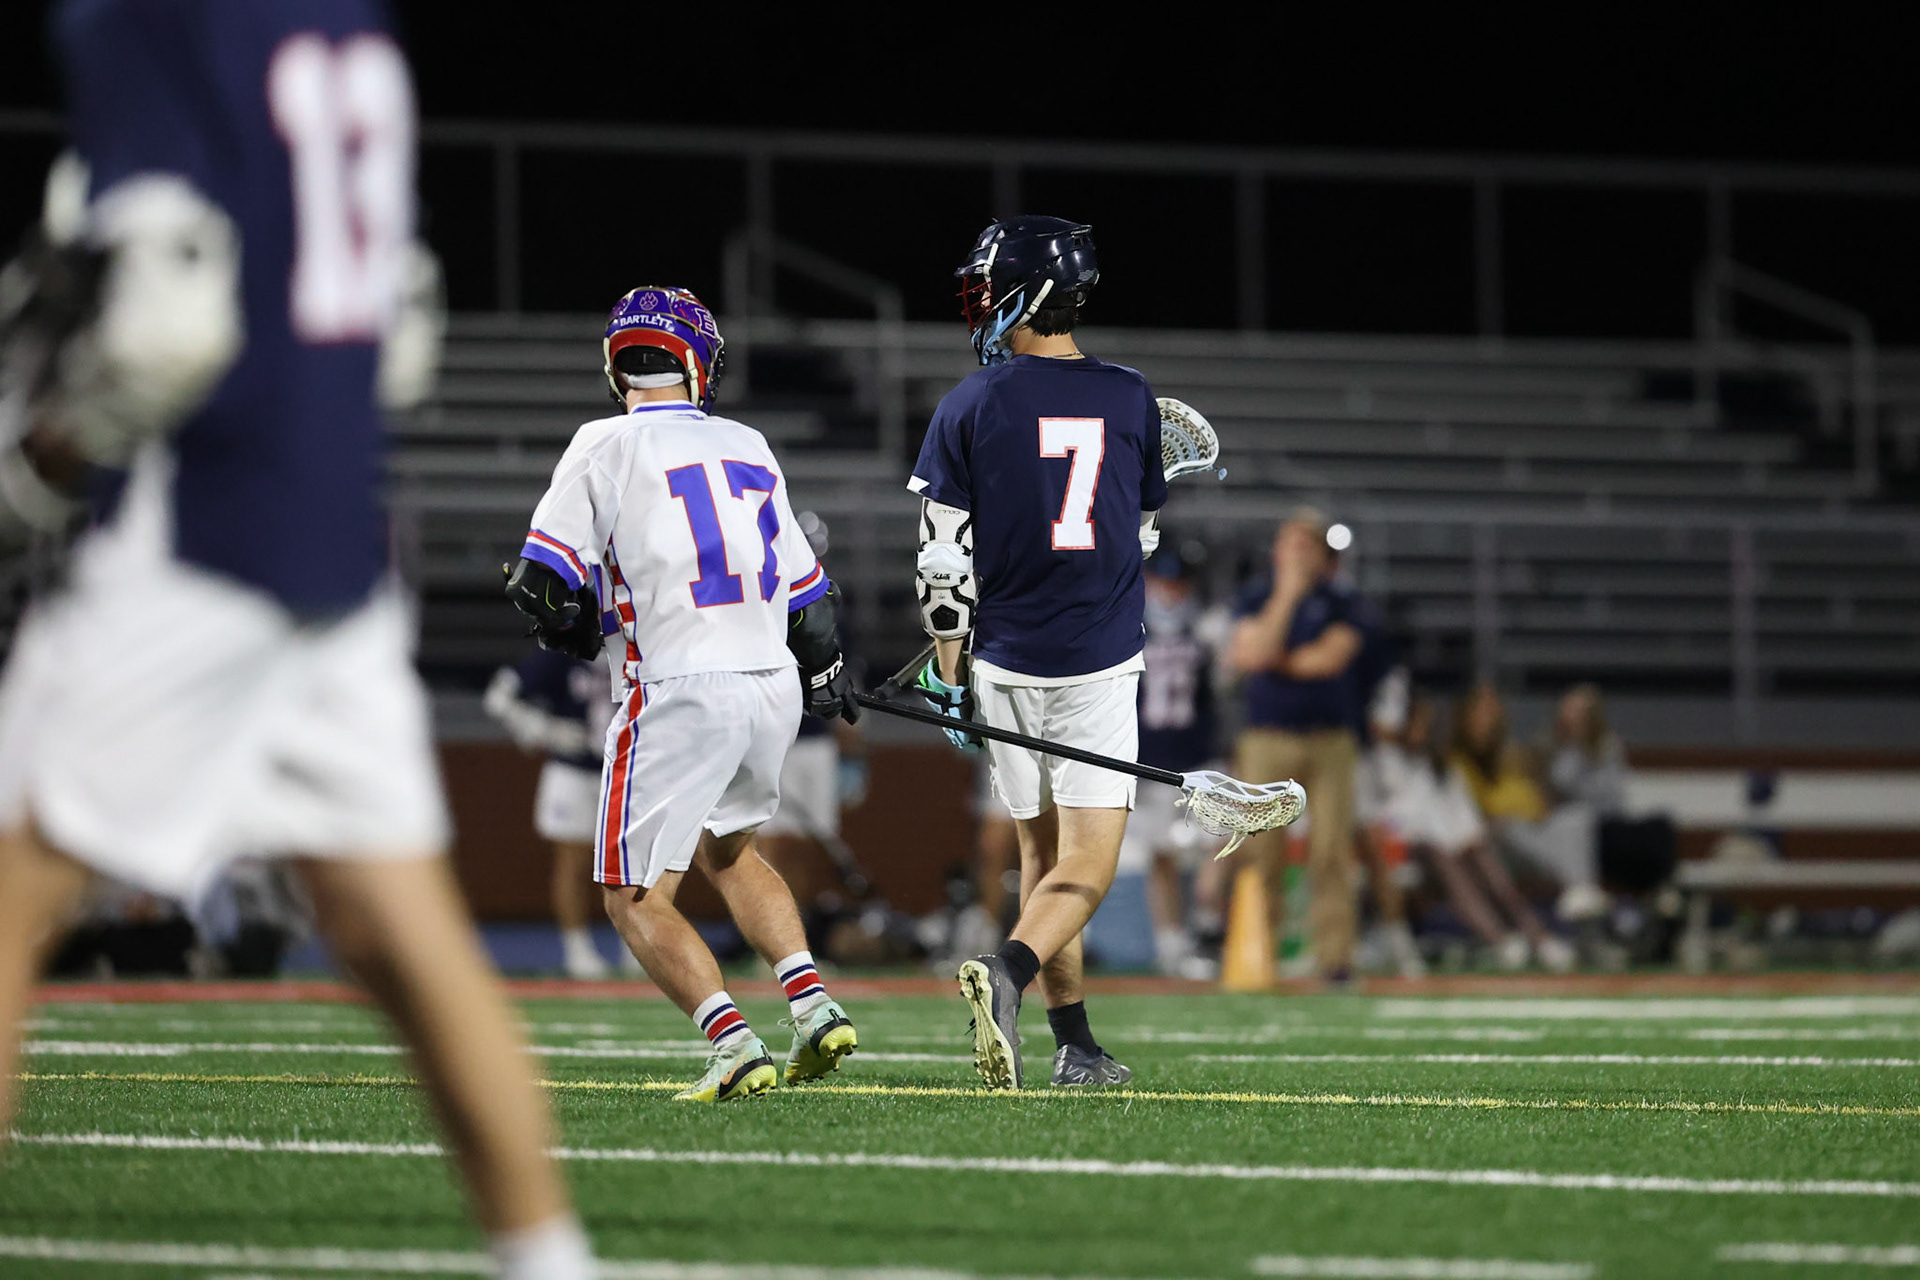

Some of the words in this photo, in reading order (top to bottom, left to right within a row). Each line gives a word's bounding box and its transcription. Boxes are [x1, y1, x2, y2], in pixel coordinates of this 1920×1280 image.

[620, 314, 673, 328] BARTLETT
[664, 459, 781, 608] 17
[1038, 416, 1105, 550] 7
